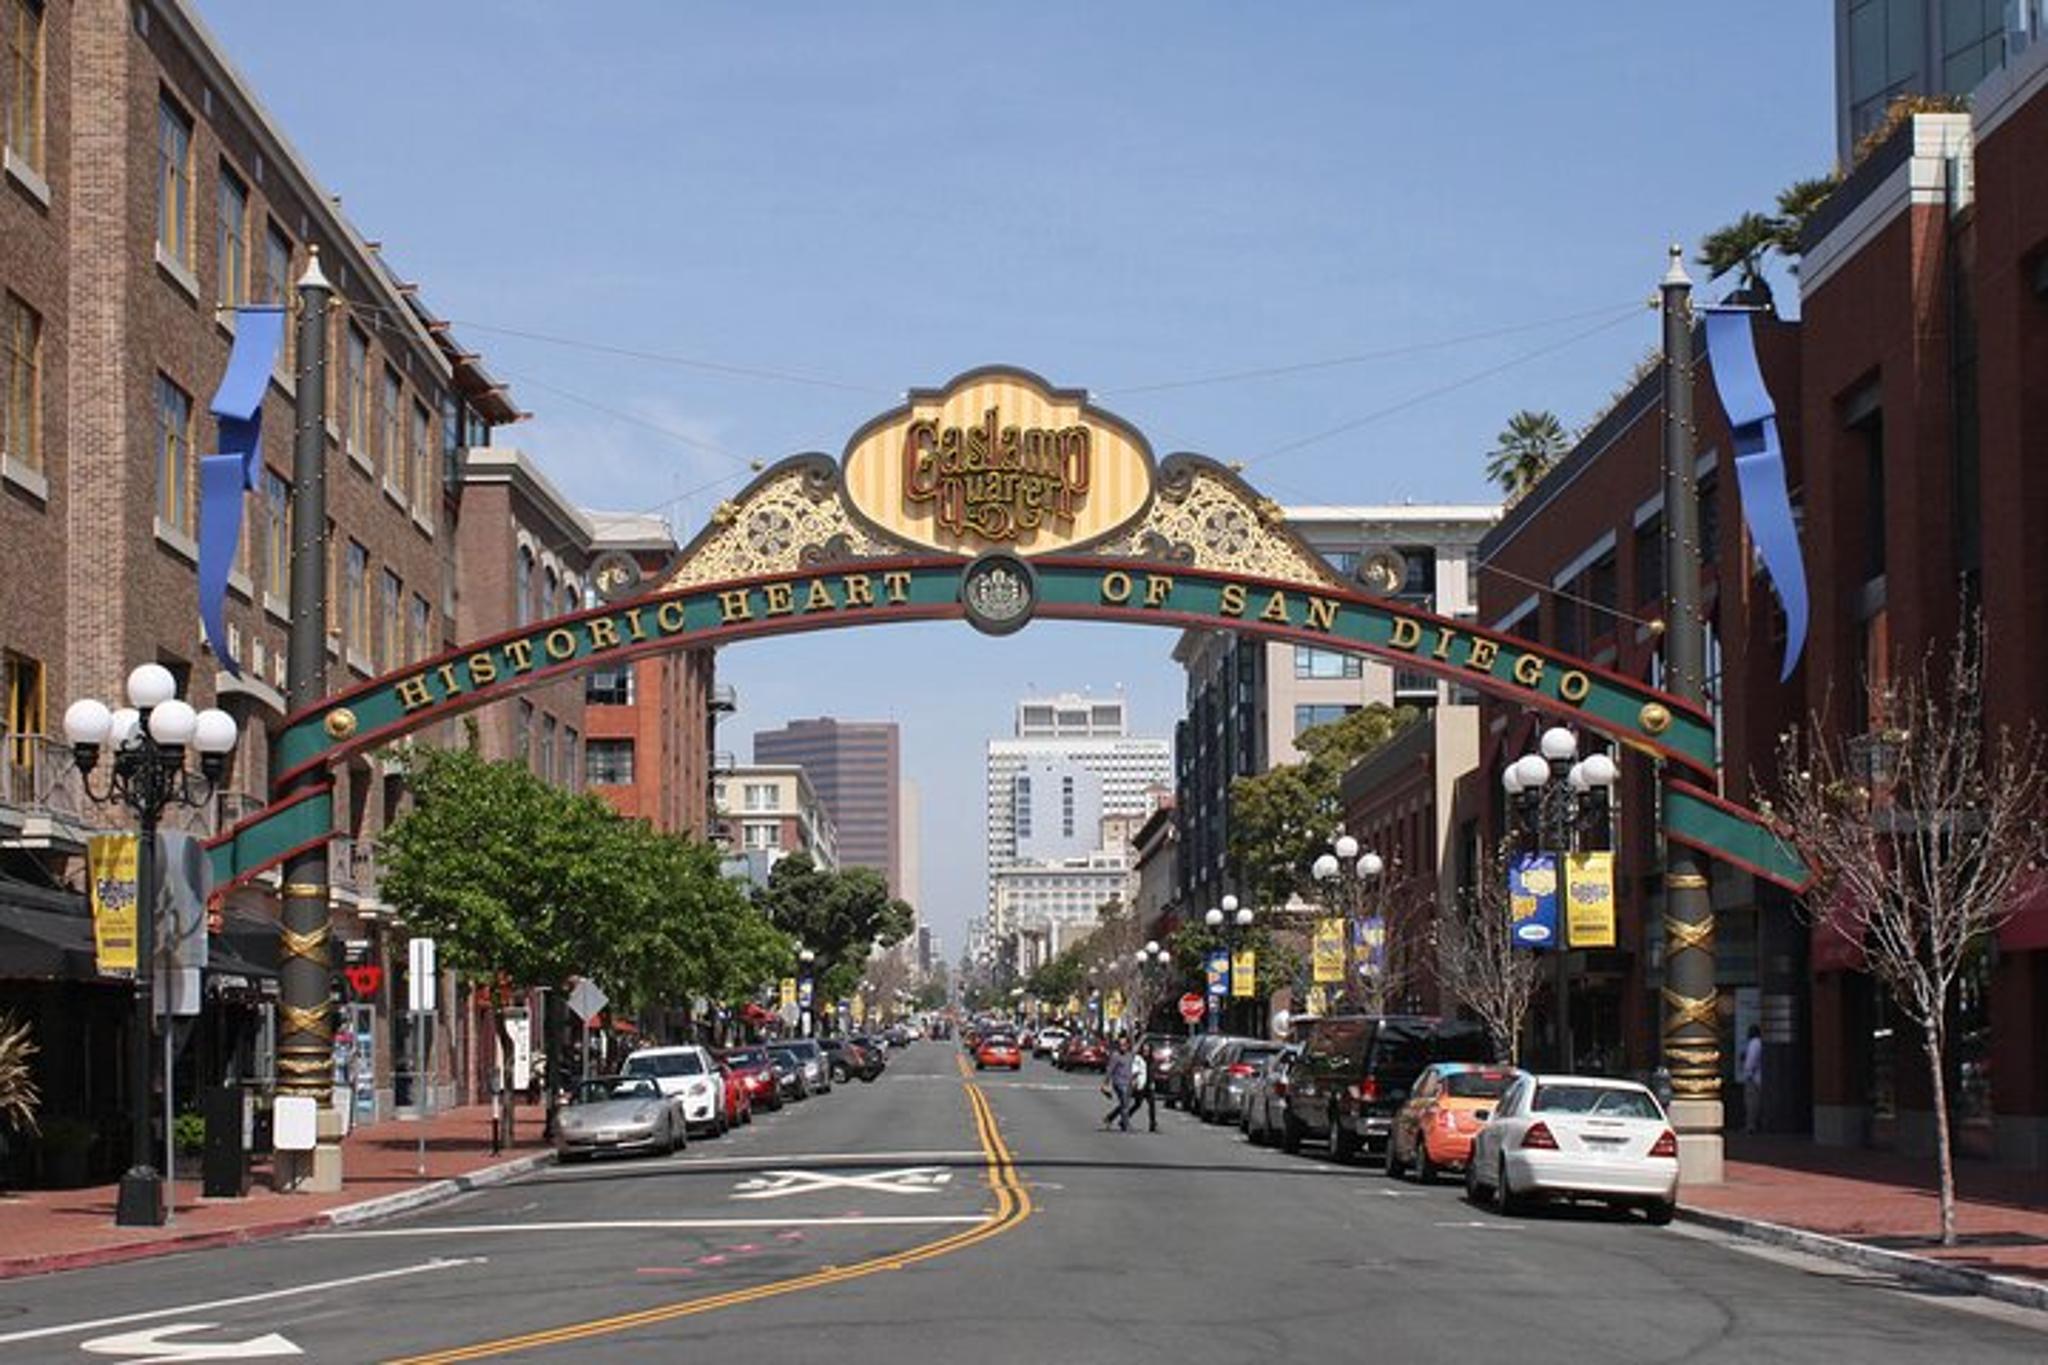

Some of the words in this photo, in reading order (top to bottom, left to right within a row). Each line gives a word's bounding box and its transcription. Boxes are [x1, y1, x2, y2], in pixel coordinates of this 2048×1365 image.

[906, 406, 1091, 524] Gaslamp
[395, 600, 686, 710] HISTORIC
[718, 571, 911, 622] HEART
[1101, 570, 1174, 605] OF
[1219, 583, 1340, 630] SAN
[1387, 616, 1590, 701] DIEGO
